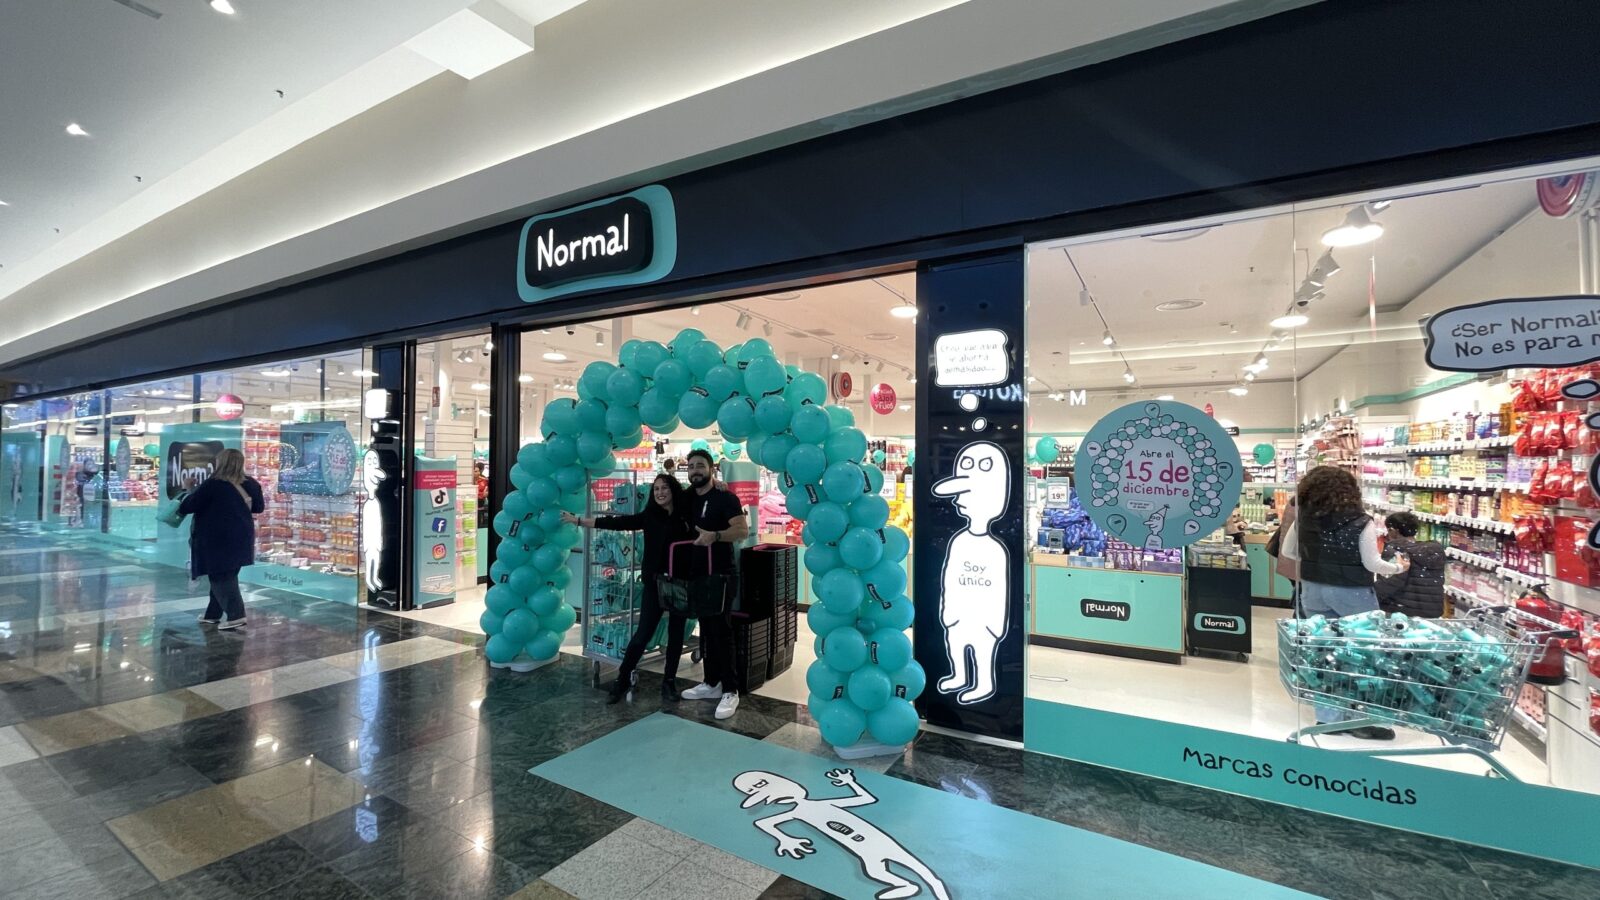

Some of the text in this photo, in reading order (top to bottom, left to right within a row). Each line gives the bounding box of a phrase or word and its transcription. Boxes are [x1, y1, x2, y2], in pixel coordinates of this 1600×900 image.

[537, 213, 629, 271] Normal
[1451, 321, 1502, 338] ¿Ser
[1455, 341, 1483, 358] No
[1492, 340, 1515, 354] es
[1525, 334, 1583, 354] para
[1140, 449, 1174, 458] Abre el
[172, 452, 214, 488] Norma
[1125, 459, 1190, 483] 15 de
[1123, 482, 1190, 497] diciembre
[963, 560, 987, 574] Soy
[958, 574, 992, 587] único
[1086, 603, 1125, 618] Normal
[1204, 617, 1235, 628] Normal
[1183, 747, 1417, 805] Marcas conocidas
